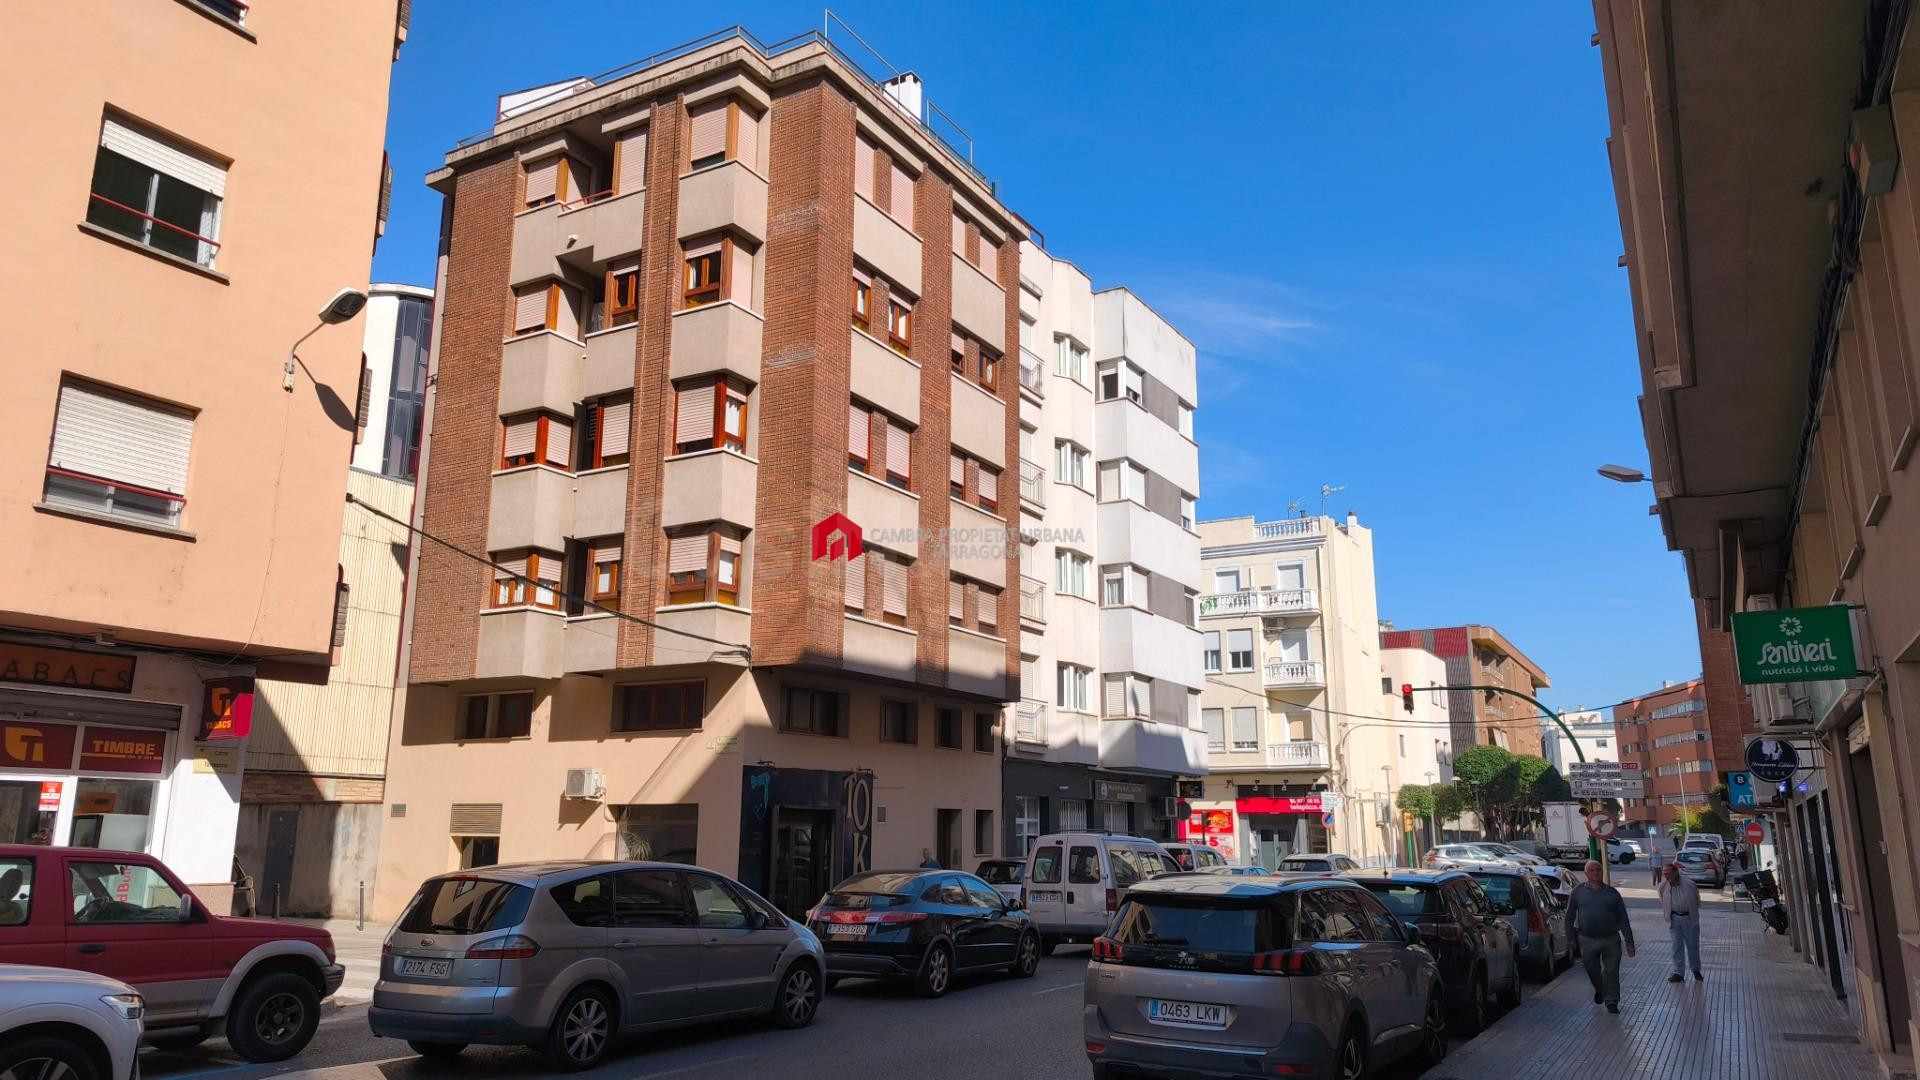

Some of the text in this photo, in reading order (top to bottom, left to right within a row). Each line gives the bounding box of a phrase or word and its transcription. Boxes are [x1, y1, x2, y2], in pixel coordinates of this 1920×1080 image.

[1757, 637, 1838, 666] Santiveri
[0, 659, 128, 688] ABACS
[1761, 667, 1802, 676] nutrició
[1812, 664, 1835, 672] vida
[92, 740, 156, 756] TIMBRE
[1209, 836, 1219, 847] 5
[406, 960, 447, 975] 2174 FSG
[1160, 1003, 1221, 1021] 0463 LKW
